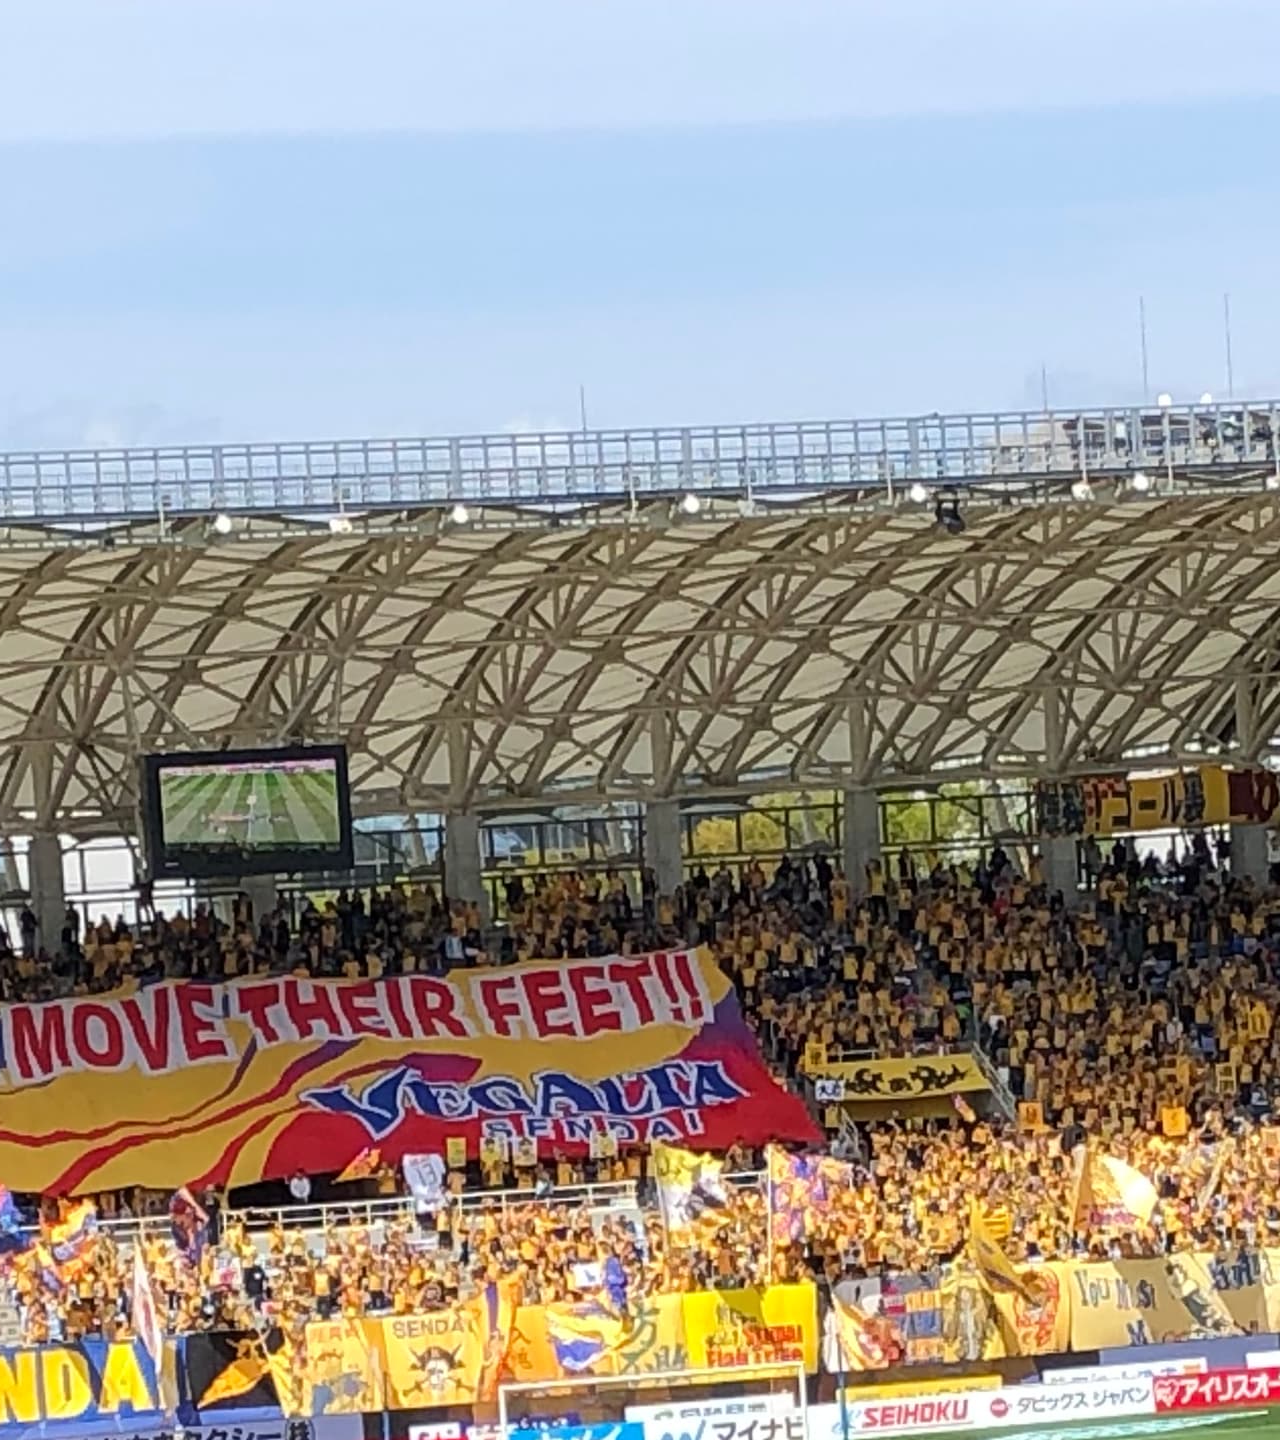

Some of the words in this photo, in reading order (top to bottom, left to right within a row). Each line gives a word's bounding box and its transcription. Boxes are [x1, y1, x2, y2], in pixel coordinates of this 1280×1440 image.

[11, 980, 237, 1081] MOVE
[232, 970, 475, 1046] THEIR
[474, 949, 712, 1041] FEET!!
[301, 1060, 750, 1142] VEGALTA
[481, 1111, 705, 1143] SENDAI
[861, 1398, 969, 1429] SEIHOKU
